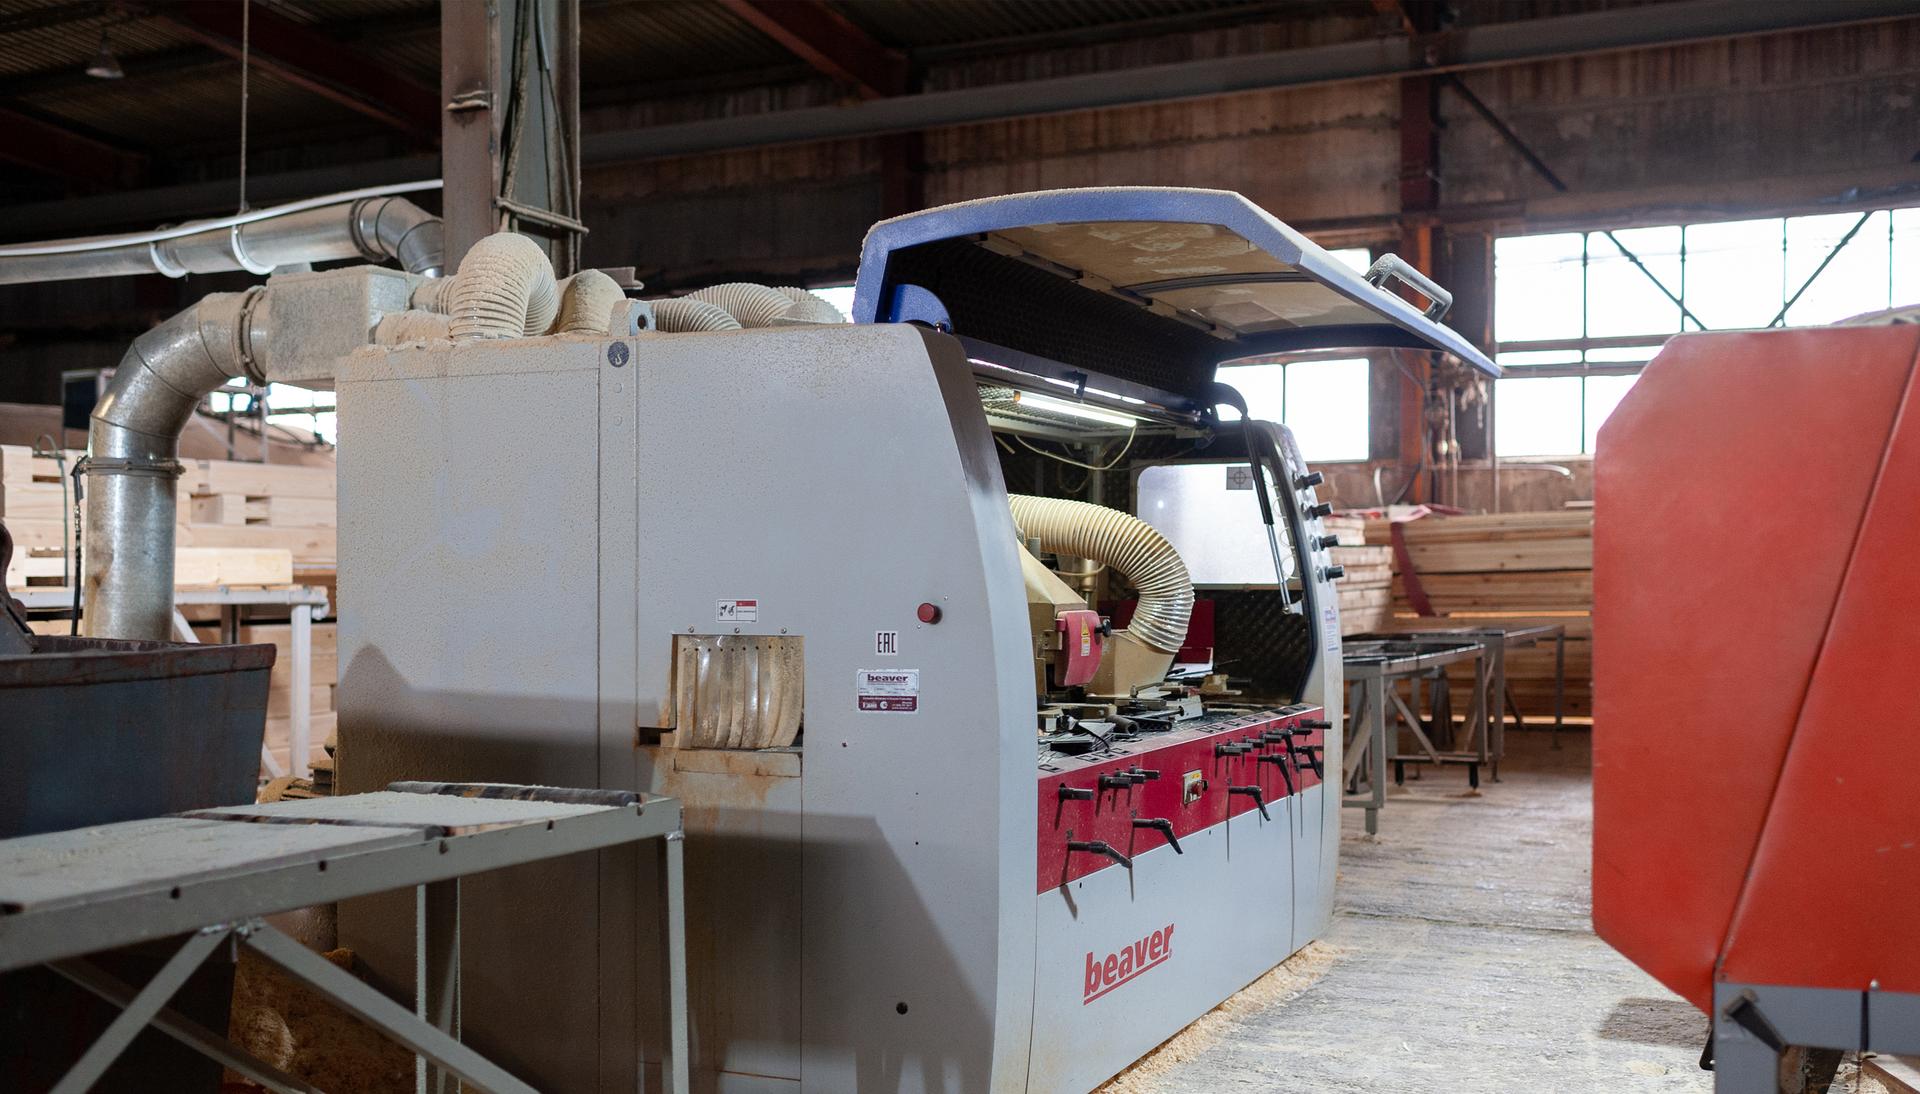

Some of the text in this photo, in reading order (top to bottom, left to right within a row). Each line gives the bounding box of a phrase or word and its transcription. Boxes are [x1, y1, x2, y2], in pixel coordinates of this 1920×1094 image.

[877, 632, 896, 653] EAC
[867, 673, 909, 681] beaver
[1083, 922, 1175, 998] beaver
